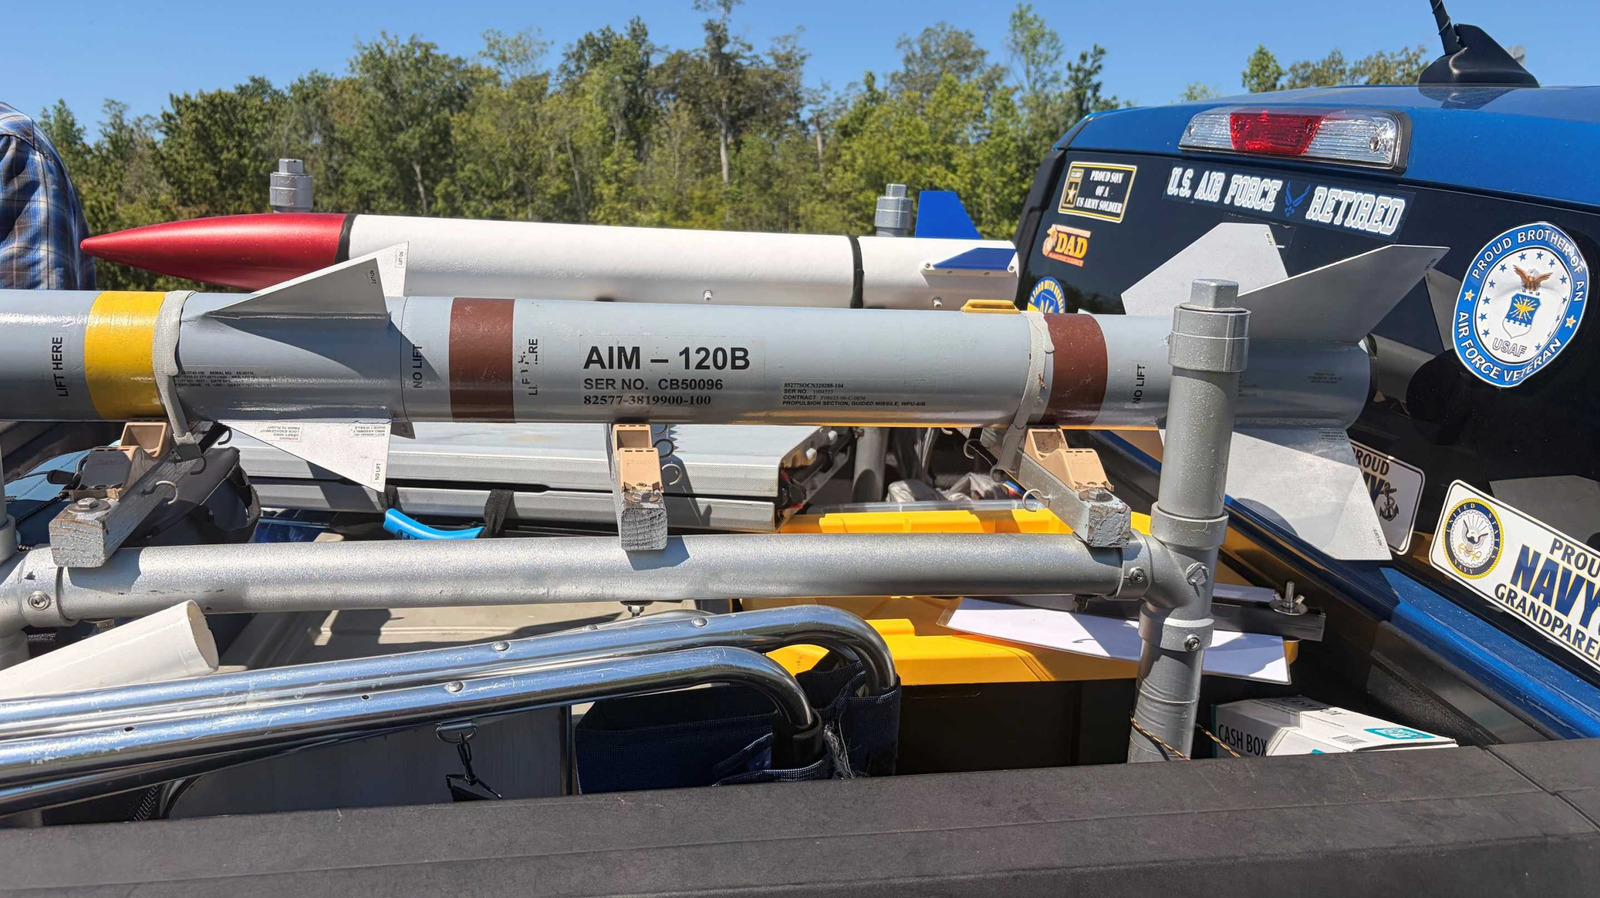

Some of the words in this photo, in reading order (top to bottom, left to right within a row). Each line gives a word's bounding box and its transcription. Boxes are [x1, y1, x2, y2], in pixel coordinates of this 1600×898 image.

[1090, 170, 1111, 182] PROUD
[1098, 201, 1123, 213] SOLDIER
[1166, 166, 1194, 198] U.S.
[1194, 170, 1226, 202] AIR
[1224, 174, 1282, 212] FORCE
[1306, 186, 1406, 236] RETIRED
[1055, 232, 1088, 258] DAD
[1517, 229, 1571, 258] BROTHER
[1472, 238, 1512, 279] PROUD
[1570, 250, 1584, 273] OF
[1573, 280, 1584, 302] AN
[1458, 312, 1470, 338] AIR
[51, 337, 62, 370] HERE
[413, 344, 422, 368] LIFT
[583, 346, 641, 370] AIM
[679, 347, 750, 370] 120B
[1461, 339, 1502, 379] FORCE
[1492, 338, 1527, 357] USAF
[1503, 339, 1562, 382] VETERAN
[53, 373, 68, 396] LIFT
[413, 372, 422, 388] NO
[584, 378, 616, 390] SER
[622, 378, 648, 390] NO.
[658, 378, 723, 390] CB50096
[1136, 364, 1145, 386] LIFT
[584, 395, 711, 405] 82577-3819900-100
[1132, 390, 1142, 404] NO
[1353, 447, 1390, 476] ROUD
[1549, 538, 1600, 578] PROU
[1510, 544, 1600, 629] NAVY
[1494, 583, 1600, 661] GRANDPARE
[1218, 724, 1243, 749] CASH
[1247, 734, 1267, 756] BOX
